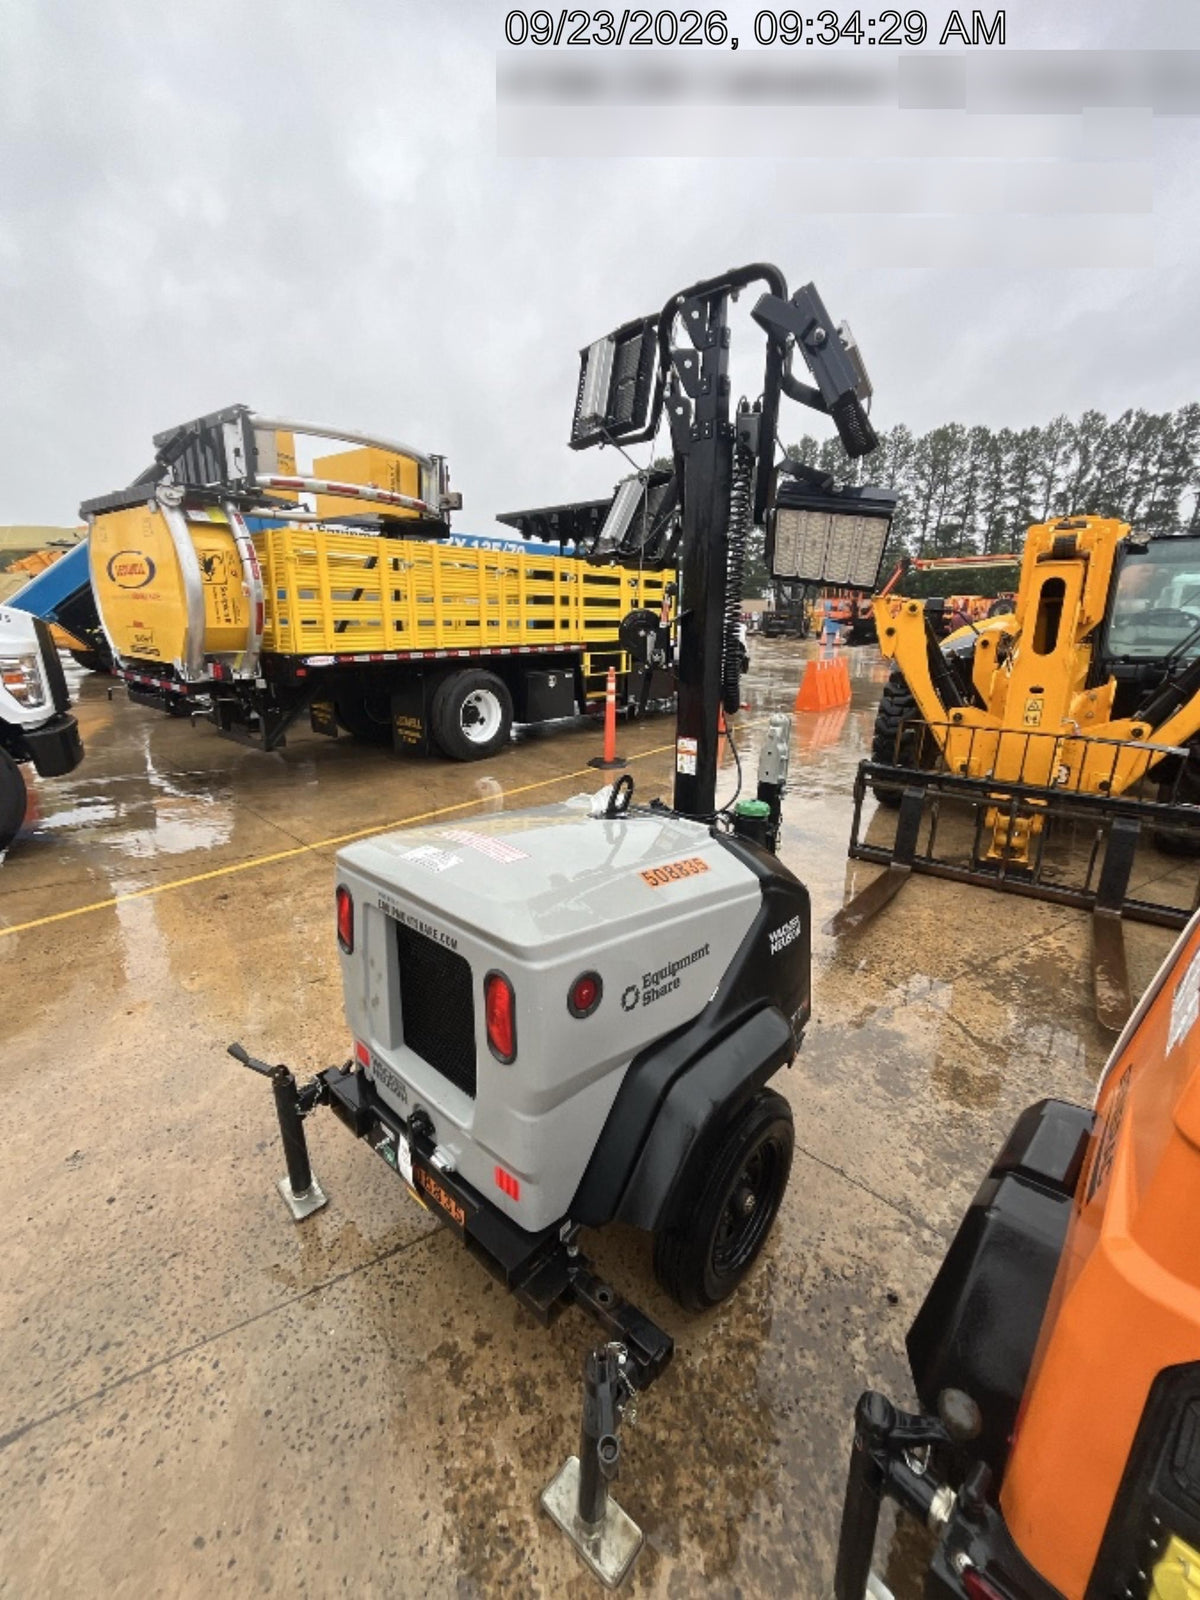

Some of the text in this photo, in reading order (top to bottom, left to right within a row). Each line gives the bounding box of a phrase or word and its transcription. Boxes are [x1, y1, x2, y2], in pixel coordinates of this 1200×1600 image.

[640, 857, 709, 887] 508835
[641, 942, 710, 990] Equipment
[642, 976, 681, 1007] Share
